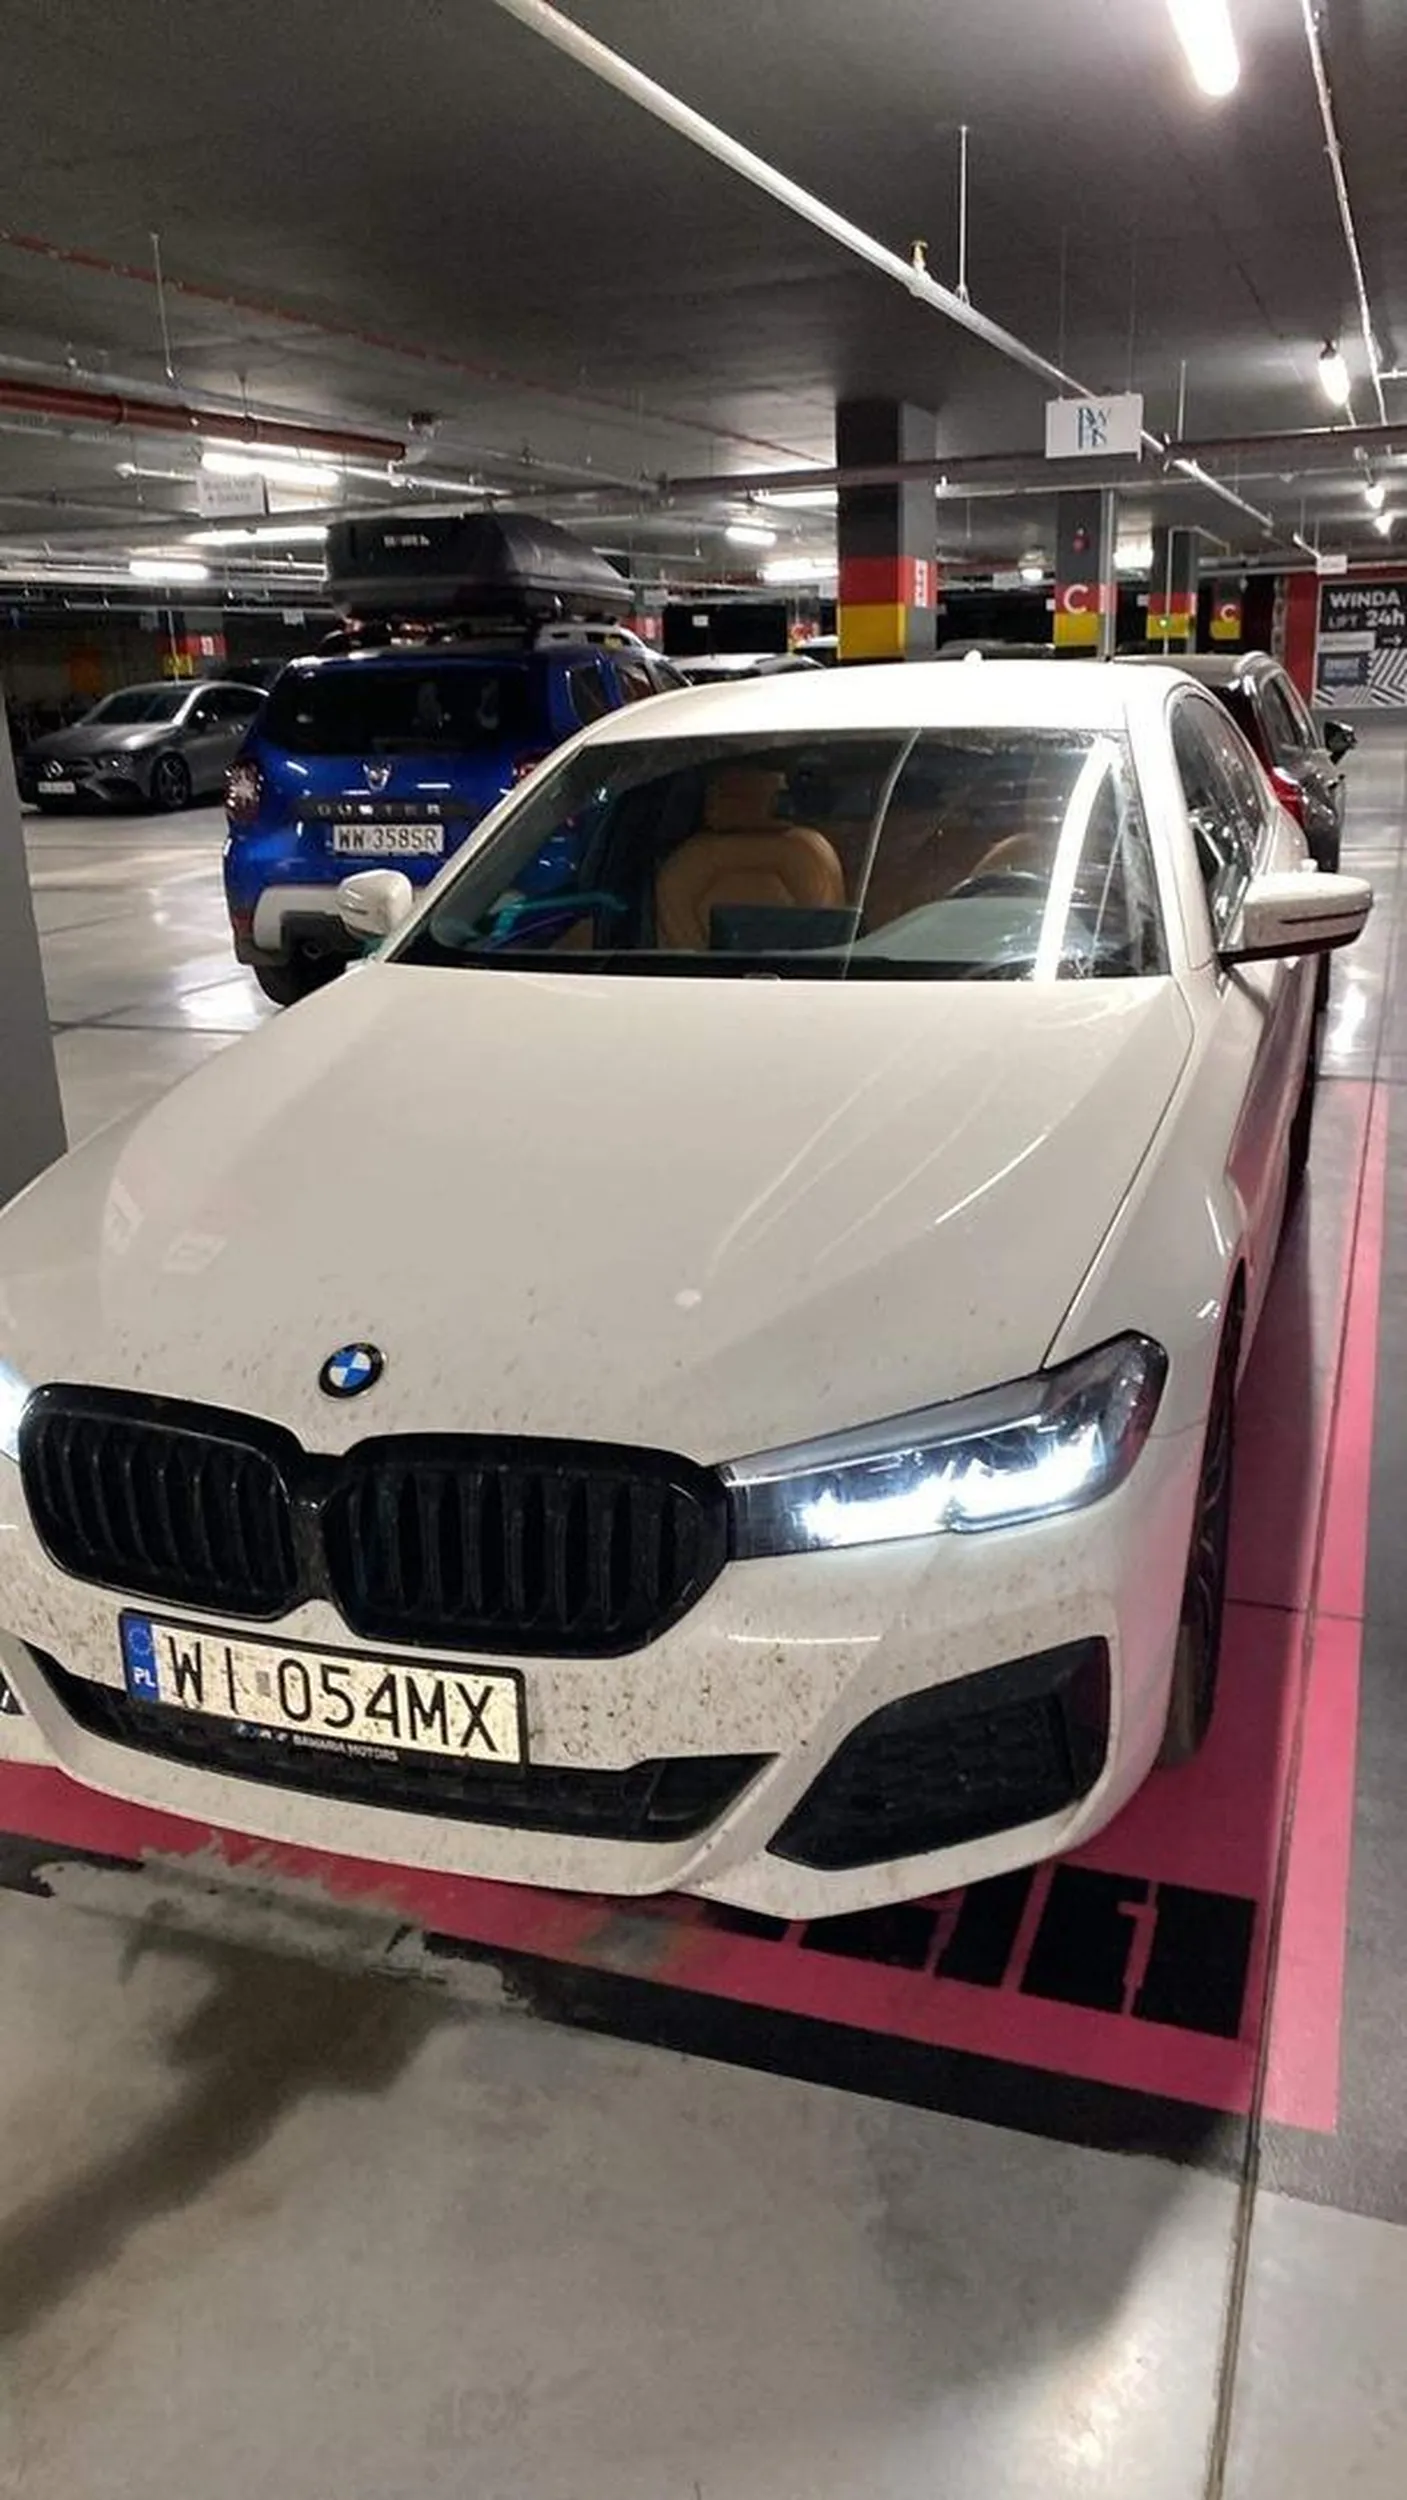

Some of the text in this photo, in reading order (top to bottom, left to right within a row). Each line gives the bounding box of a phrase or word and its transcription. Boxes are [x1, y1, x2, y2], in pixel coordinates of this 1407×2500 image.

[1064, 583, 1088, 614] C
[1329, 588, 1401, 608] WINDA
[1365, 607, 1405, 627] 24h
[133, 1666, 155, 1687] PL
[168, 1636, 497, 1753] WI 054MX
